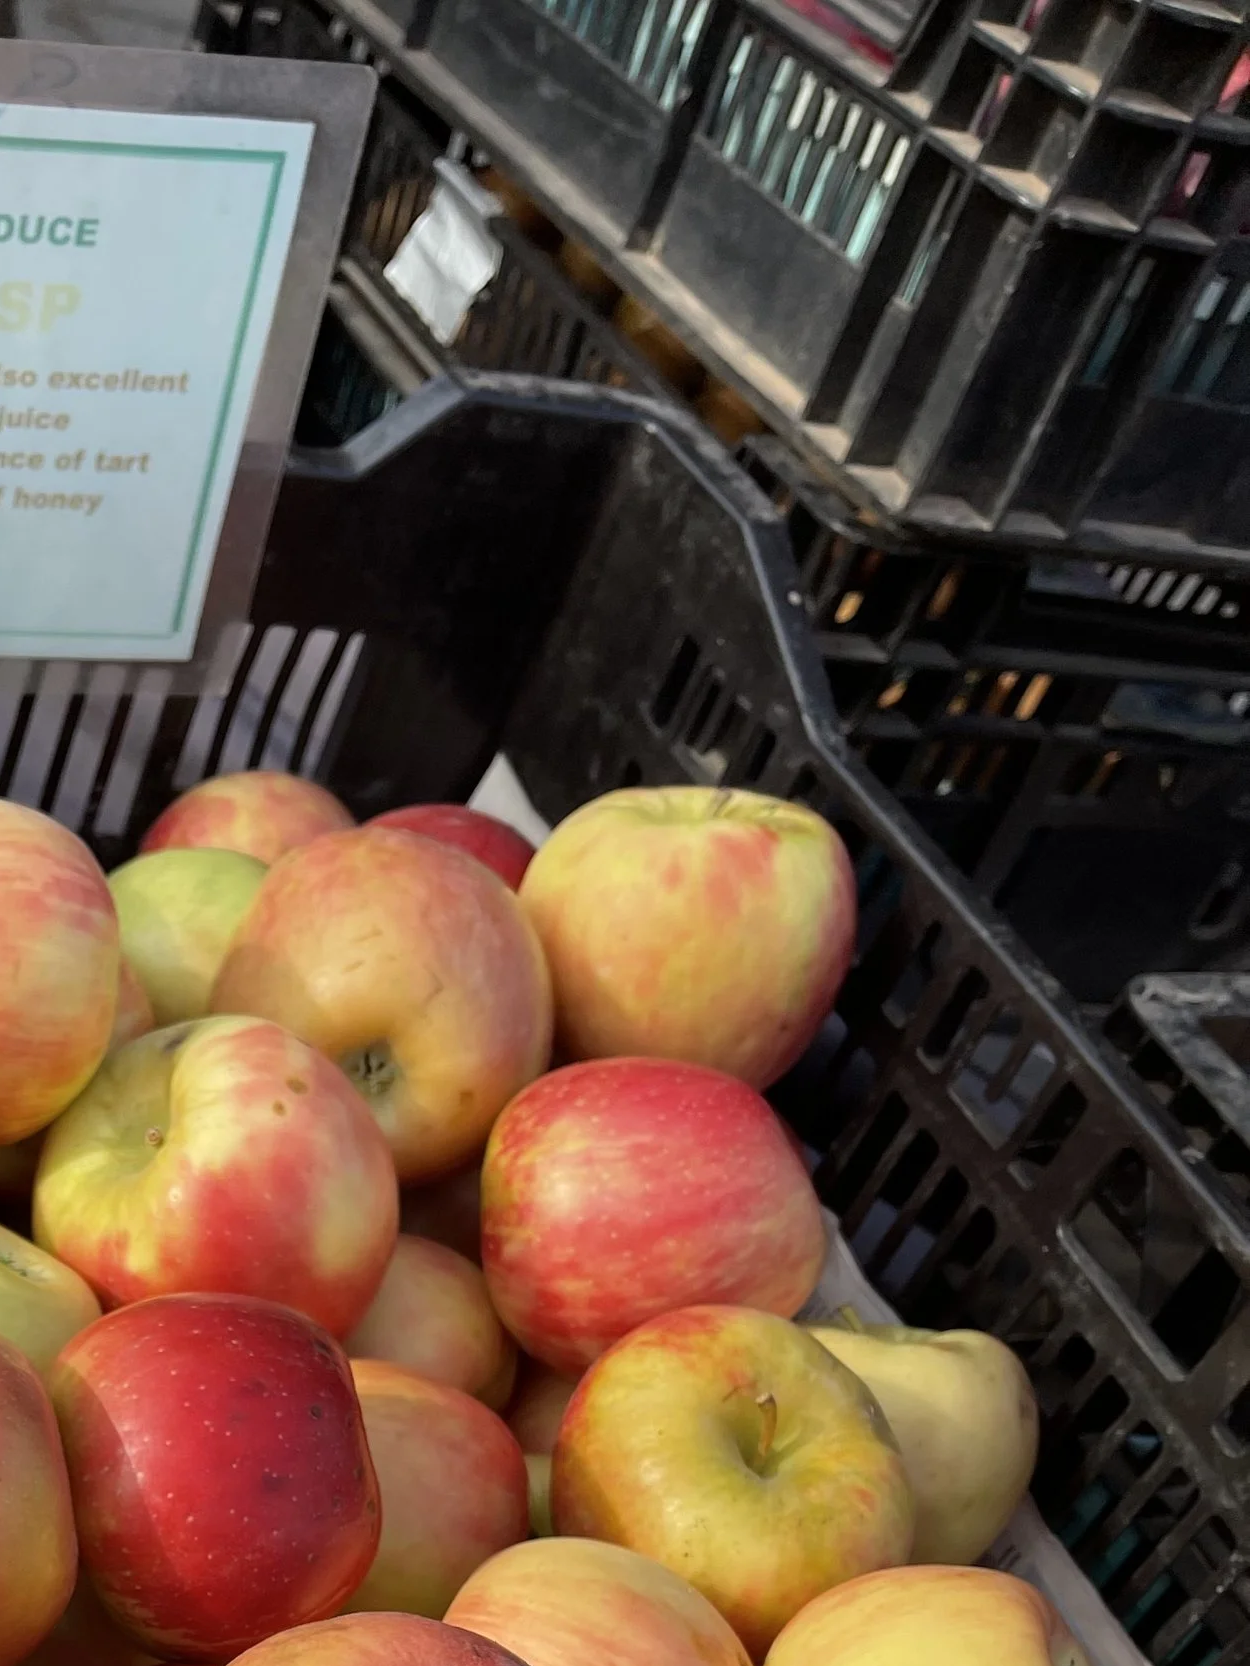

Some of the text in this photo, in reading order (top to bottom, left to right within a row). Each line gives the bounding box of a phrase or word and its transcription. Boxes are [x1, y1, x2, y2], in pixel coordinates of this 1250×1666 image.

[48, 368, 189, 395] excellent
[55, 448, 85, 471] of
[95, 451, 149, 474] tart
[12, 485, 103, 516] honey
